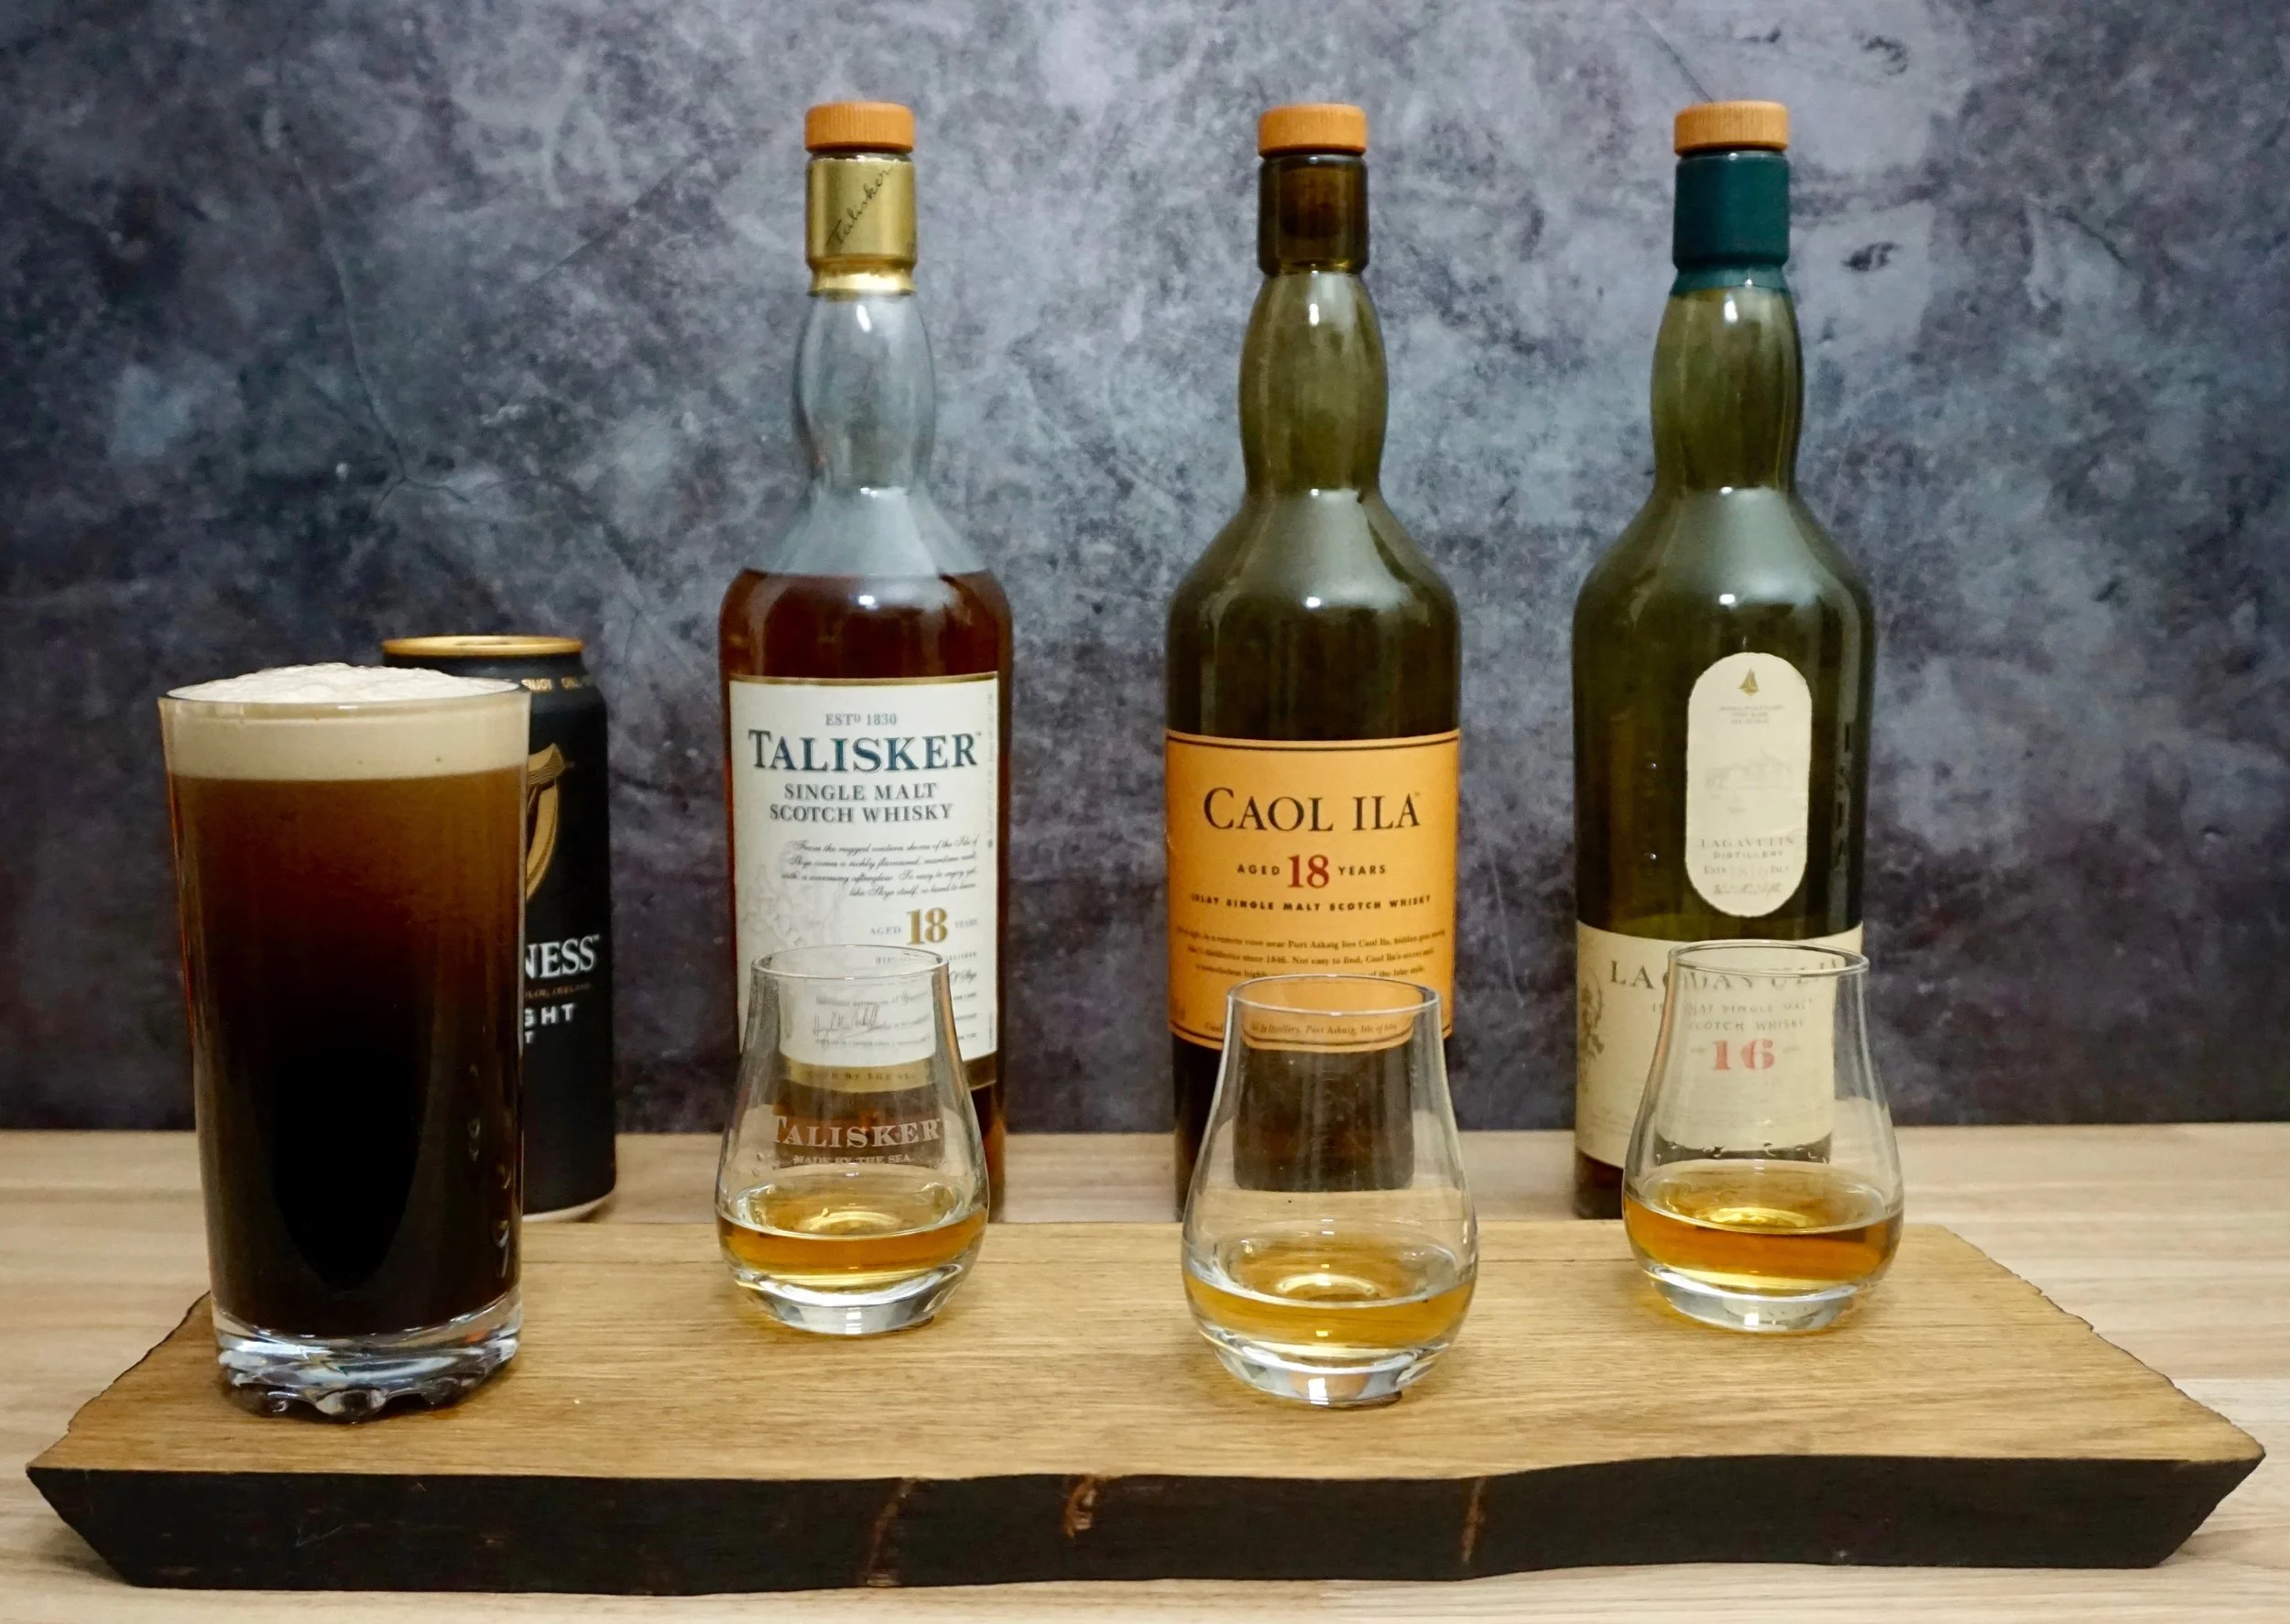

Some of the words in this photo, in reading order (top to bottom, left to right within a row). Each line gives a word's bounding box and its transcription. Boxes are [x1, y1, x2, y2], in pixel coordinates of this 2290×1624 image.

[866, 714, 898, 726] 1830
[747, 729, 978, 773] TALISKER
[783, 783, 865, 802] SINGLE
[874, 782, 938, 801] MALT
[769, 803, 854, 824] SCOTCH
[862, 803, 953, 823] WHISKY
[1203, 787, 1334, 832] CAOL
[1351, 793, 1421, 831] ILA
[1237, 864, 1281, 876] AGED
[1288, 855, 1330, 888] 18
[1338, 864, 1386, 876] YEARS
[1226, 898, 1275, 910] SINGLE
[1283, 901, 1321, 911] MALT
[1330, 900, 1381, 911] SCOTCH
[1390, 894, 1432, 909] WHISKY
[869, 926, 902, 935] AGED
[906, 907, 948, 945] 18
[525, 935, 595, 979] NESS
[1711, 1038, 1775, 1072] 16
[889, 1154, 911, 1162] SEA
